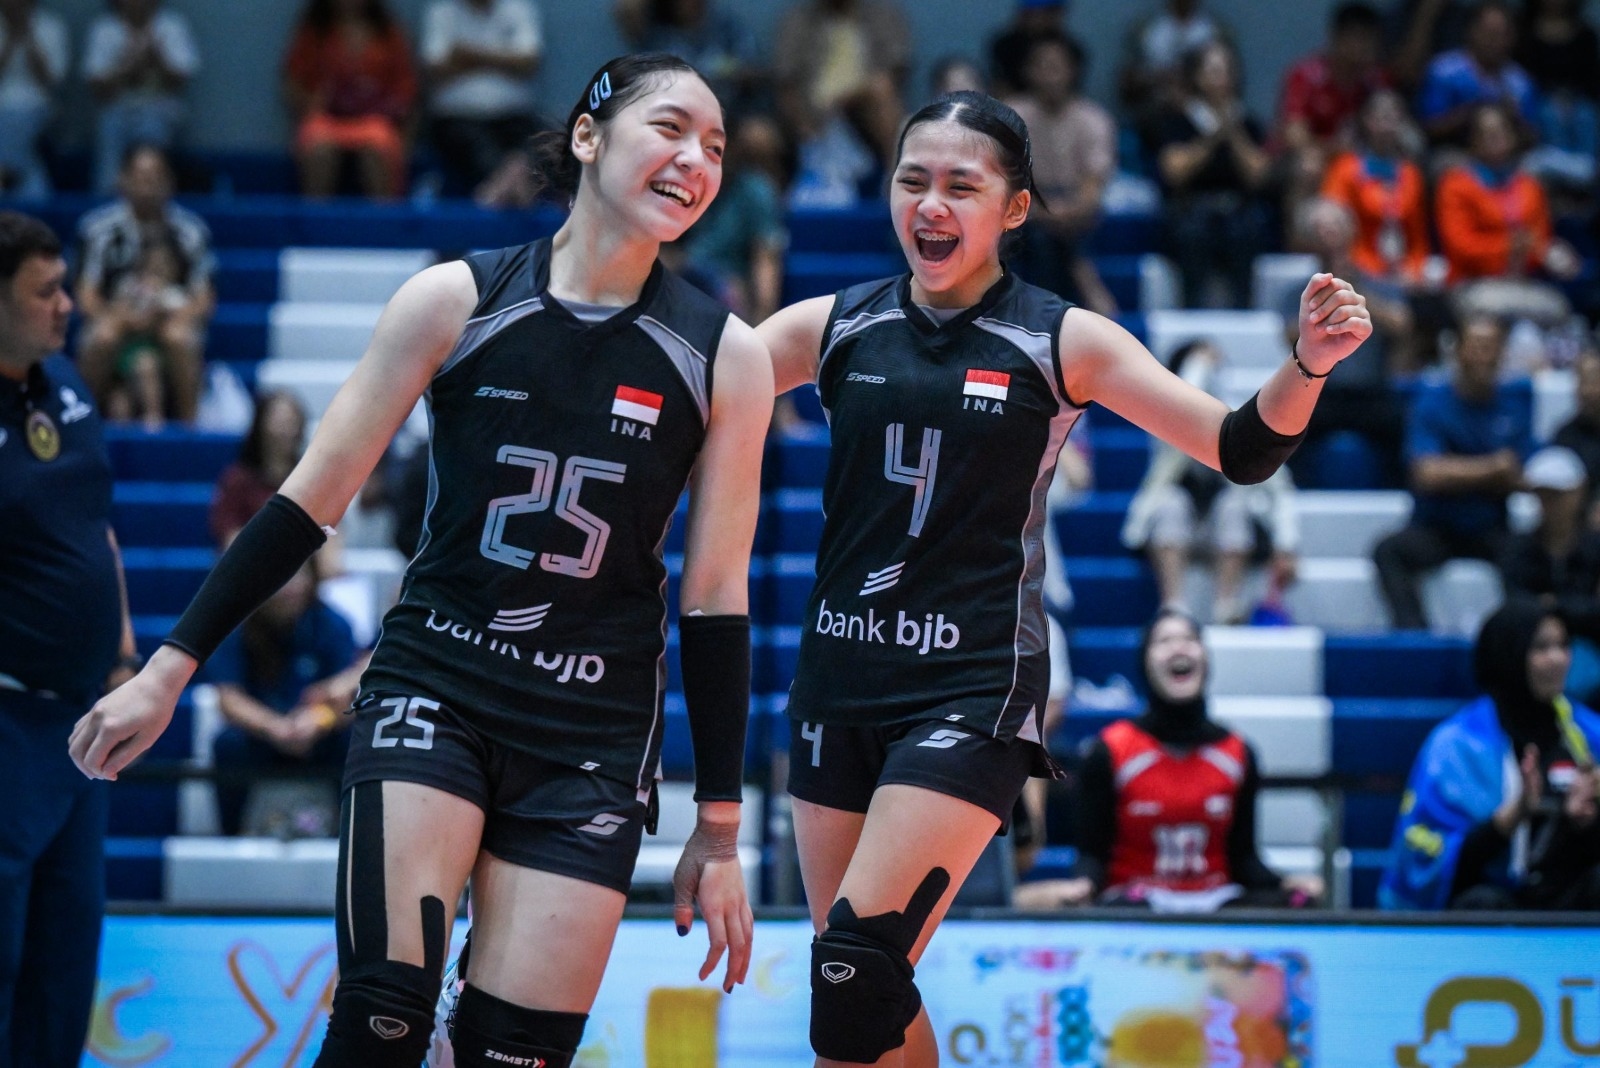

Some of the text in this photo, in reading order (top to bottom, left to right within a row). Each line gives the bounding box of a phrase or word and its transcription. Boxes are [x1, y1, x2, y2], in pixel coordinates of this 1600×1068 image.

[489, 389, 529, 400] SPEED
[963, 397, 1004, 415] INA
[610, 418, 652, 441] INA
[884, 422, 942, 538] 4
[480, 444, 627, 579] 25
[816, 599, 960, 655] bank bjb
[372, 696, 441, 750] 25
[801, 721, 824, 768] 4
